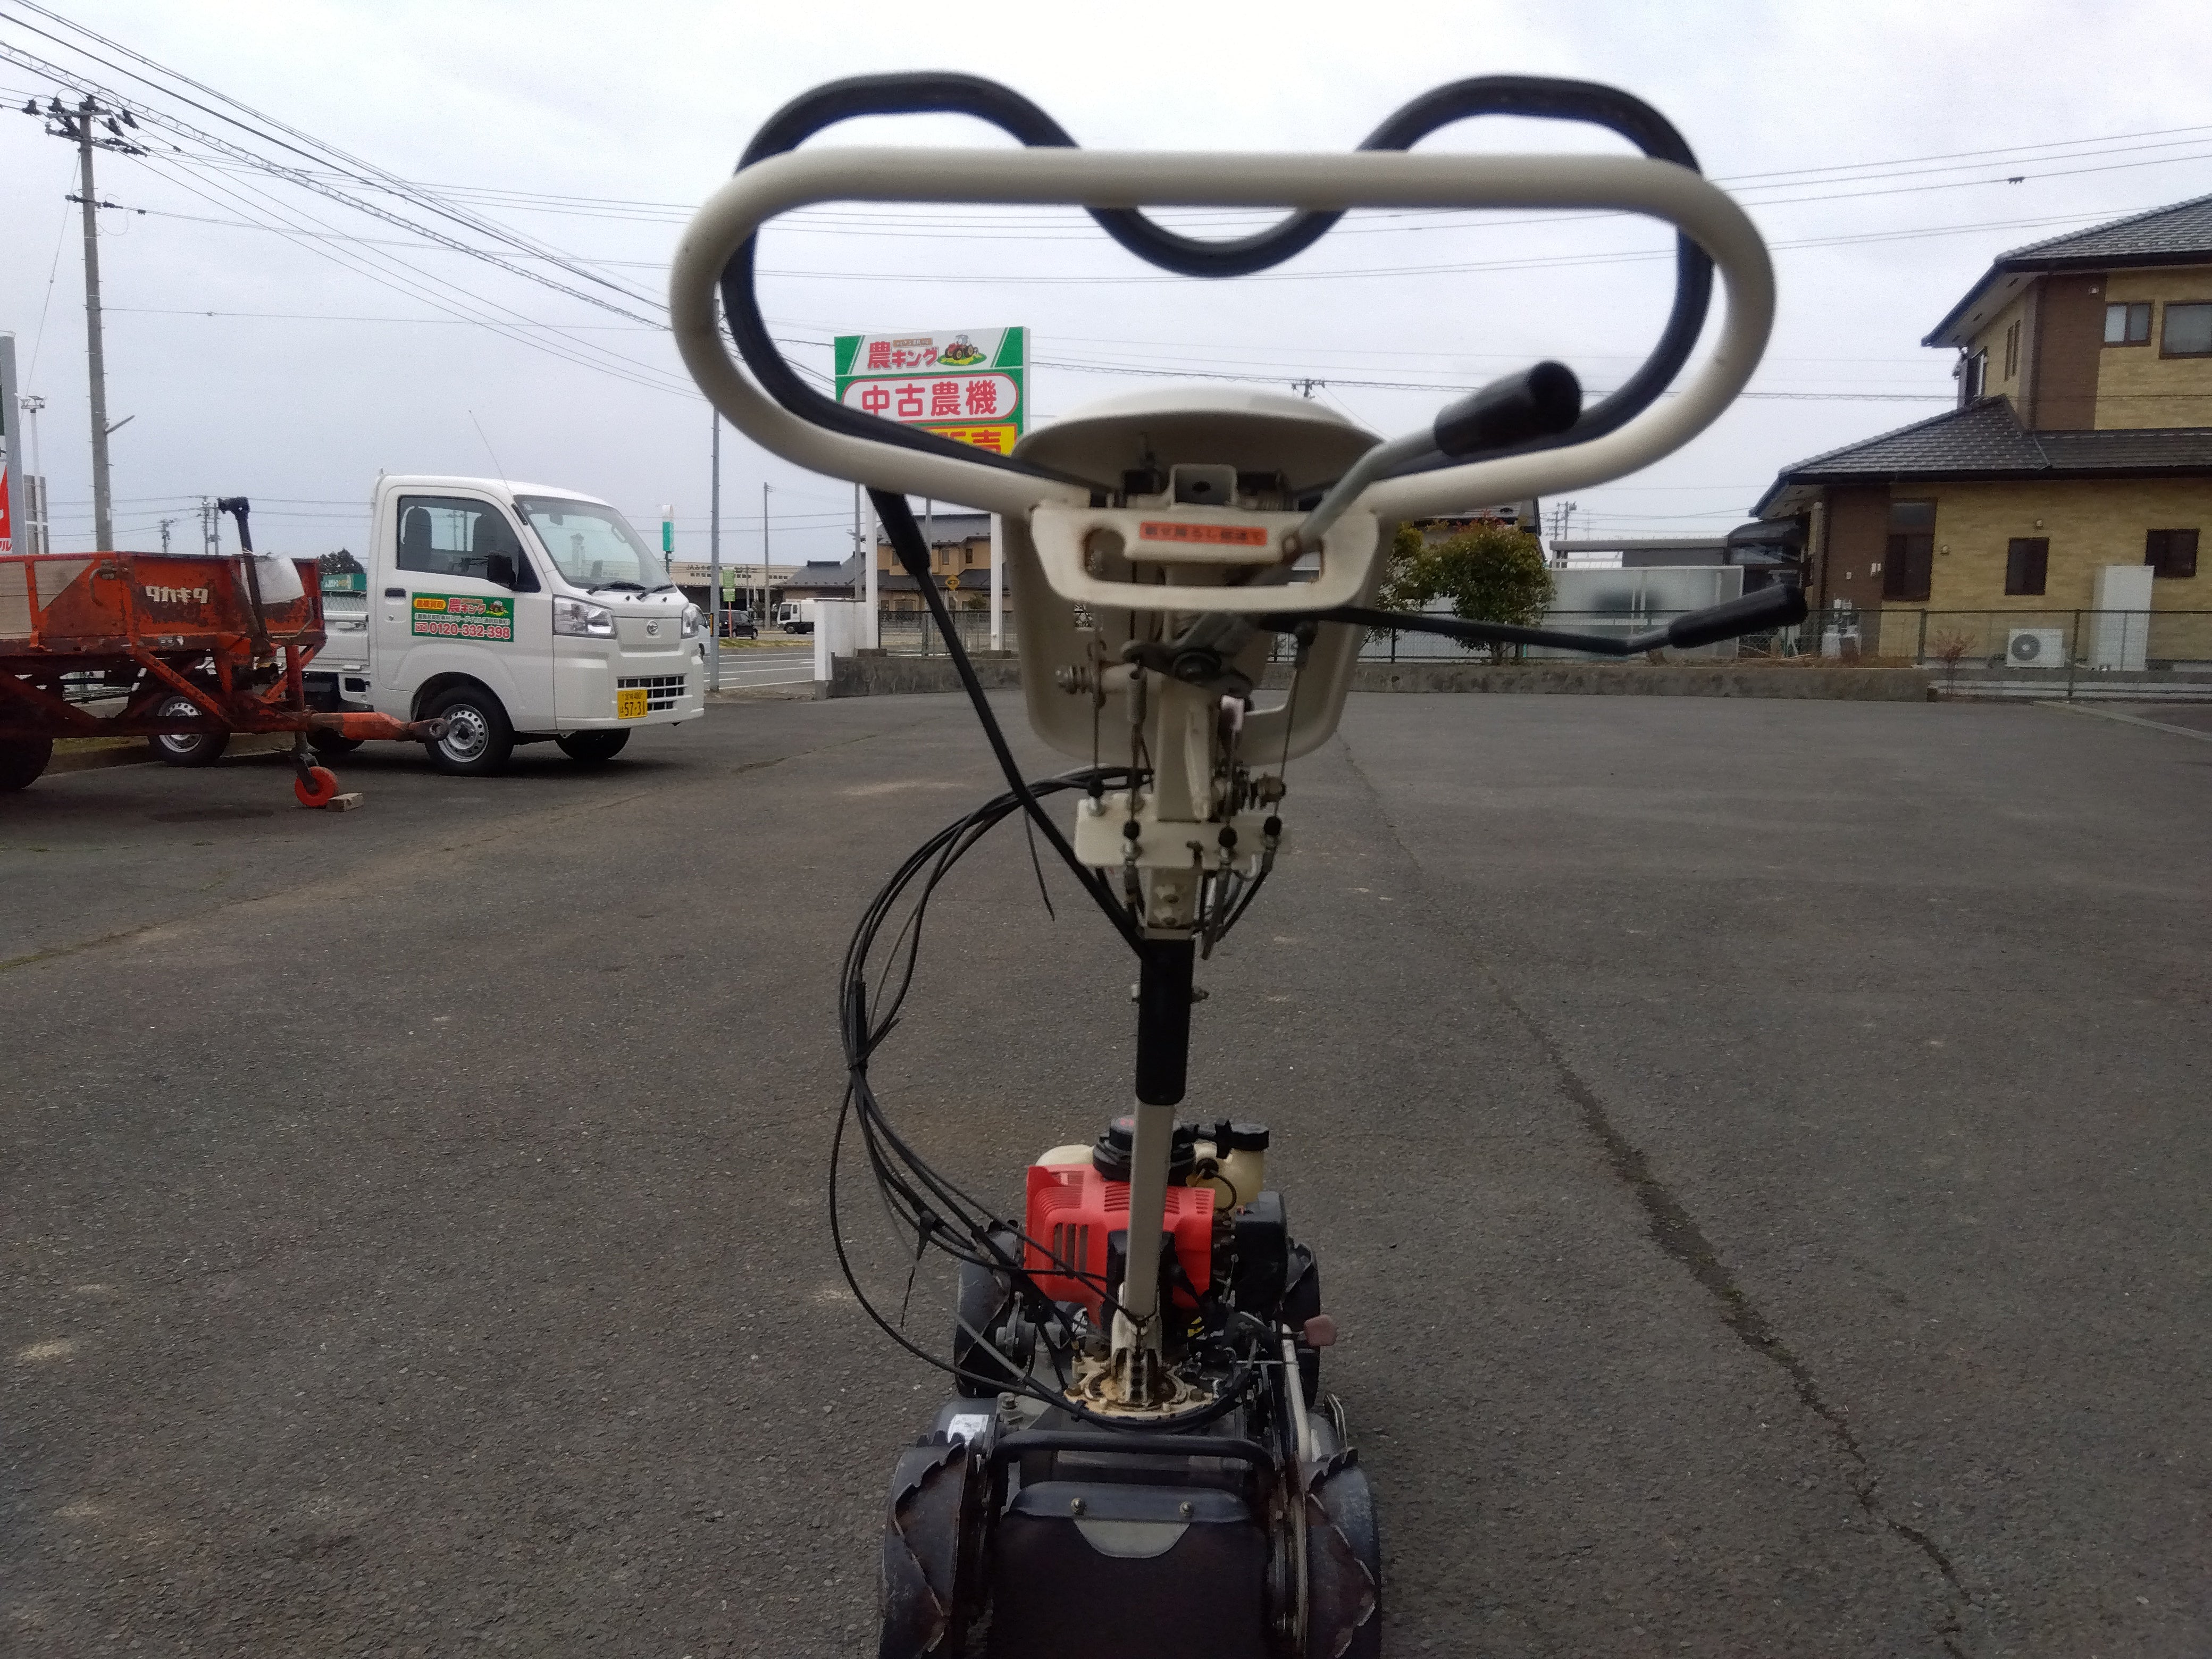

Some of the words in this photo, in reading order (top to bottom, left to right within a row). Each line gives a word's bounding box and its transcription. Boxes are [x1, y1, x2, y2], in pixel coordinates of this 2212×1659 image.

[868, 341, 938, 369] 農キング
[861, 380, 997, 417] 中古農機
[146, 585, 208, 604] タカキタ
[448, 598, 486, 614] 農キング
[429, 622, 511, 639] 0120-332-398
